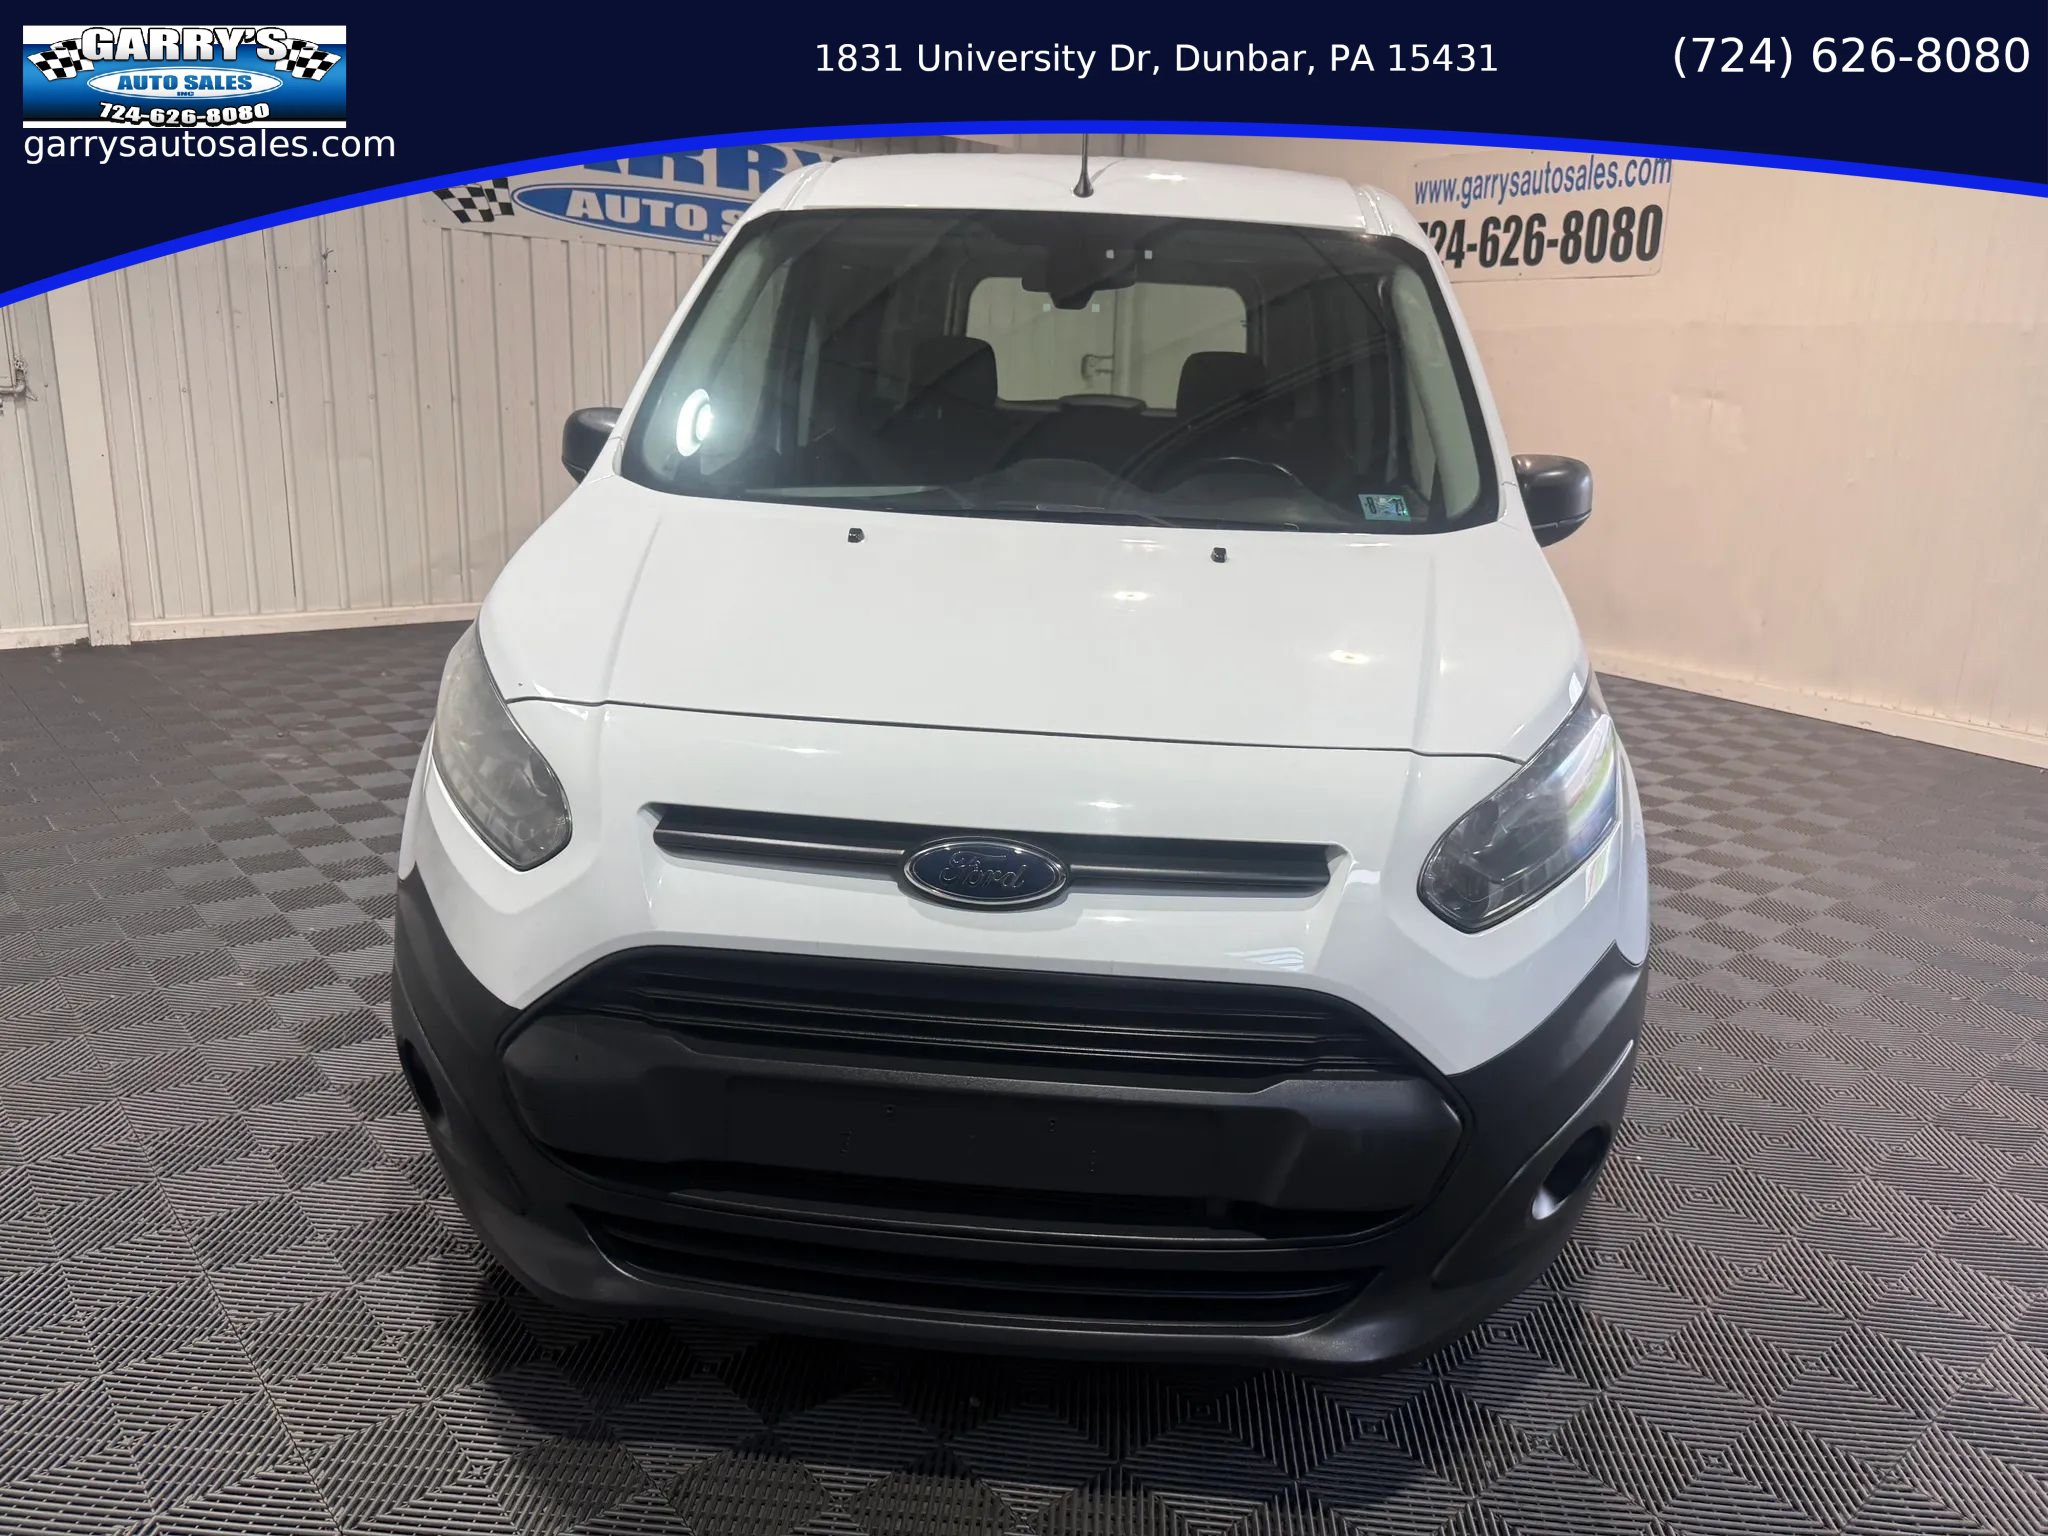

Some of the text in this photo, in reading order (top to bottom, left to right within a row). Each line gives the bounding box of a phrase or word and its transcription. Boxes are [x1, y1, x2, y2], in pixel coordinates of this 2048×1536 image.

[1414, 154, 1672, 209] www.garrysautosales.com
[565, 190, 708, 231] AUTO
[939, 851, 1028, 888] Ford
